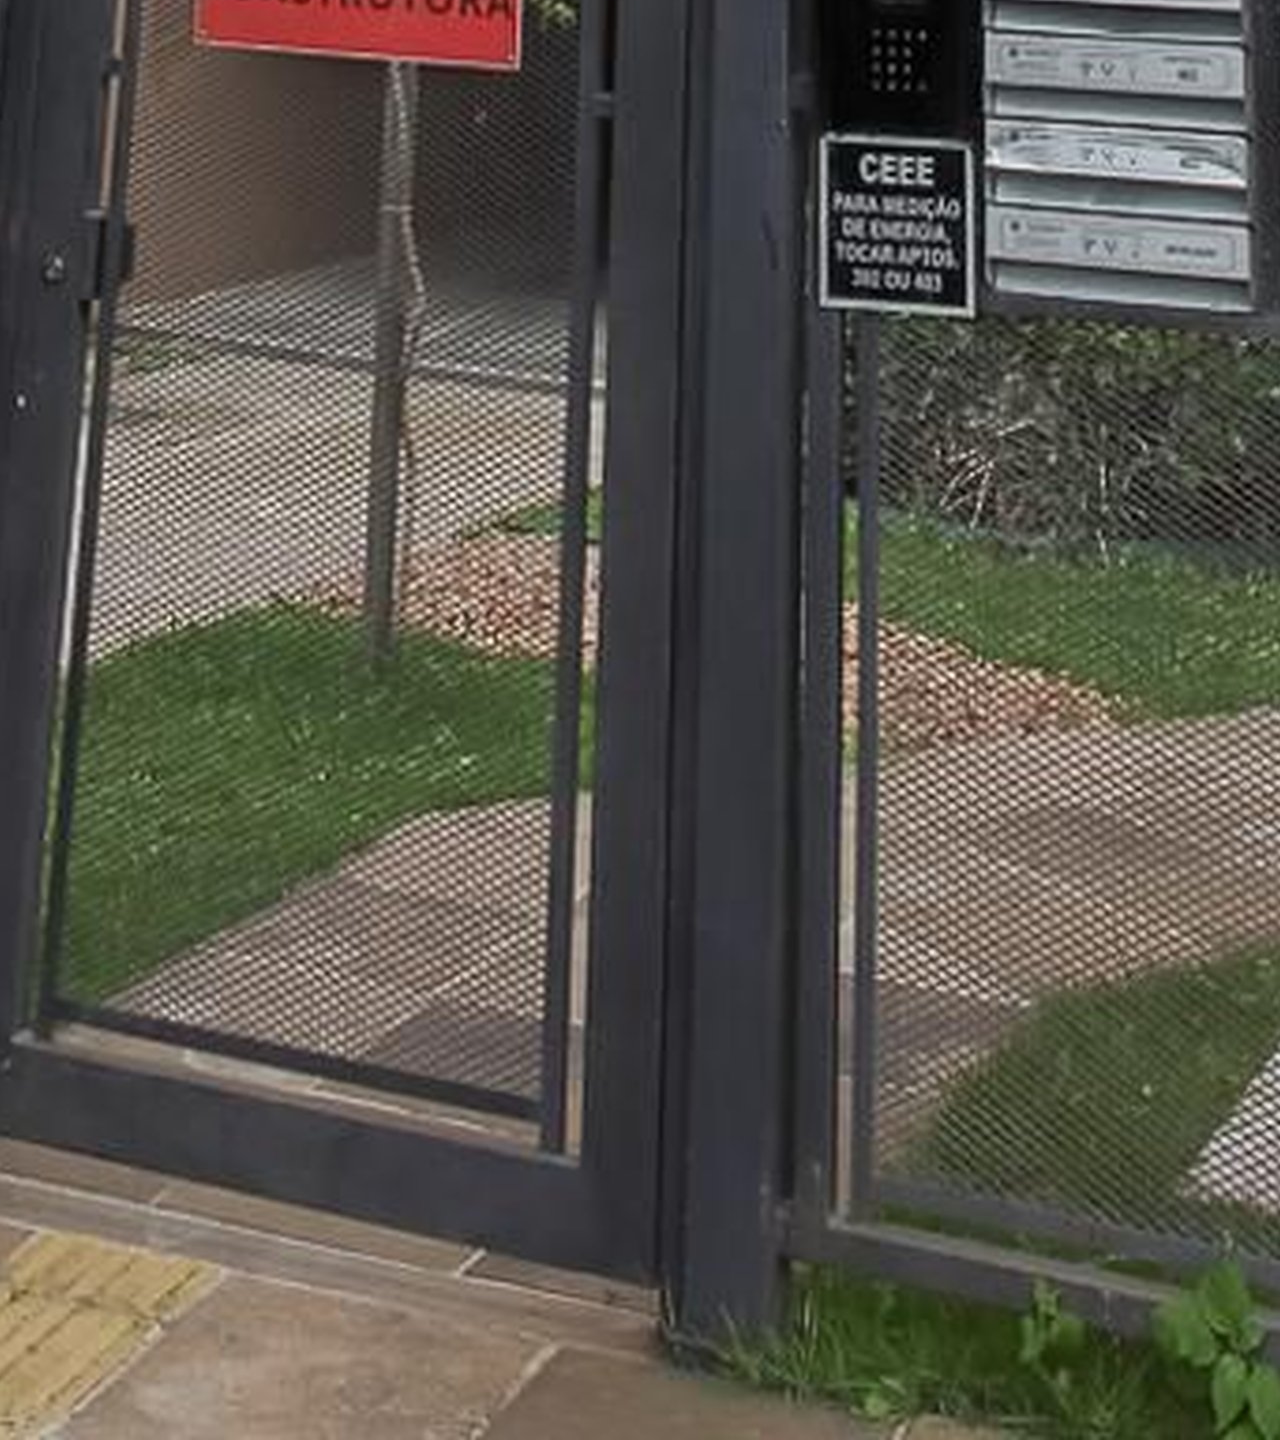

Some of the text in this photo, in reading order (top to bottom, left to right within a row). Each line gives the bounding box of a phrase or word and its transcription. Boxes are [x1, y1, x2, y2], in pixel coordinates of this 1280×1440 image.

[859, 153, 935, 186] CEEE
[833, 191, 961, 220] PARA MEDIÇÃO
[841, 217, 866, 239] DE
[835, 239, 895, 263] TOCAR
[884, 270, 911, 290] OU
